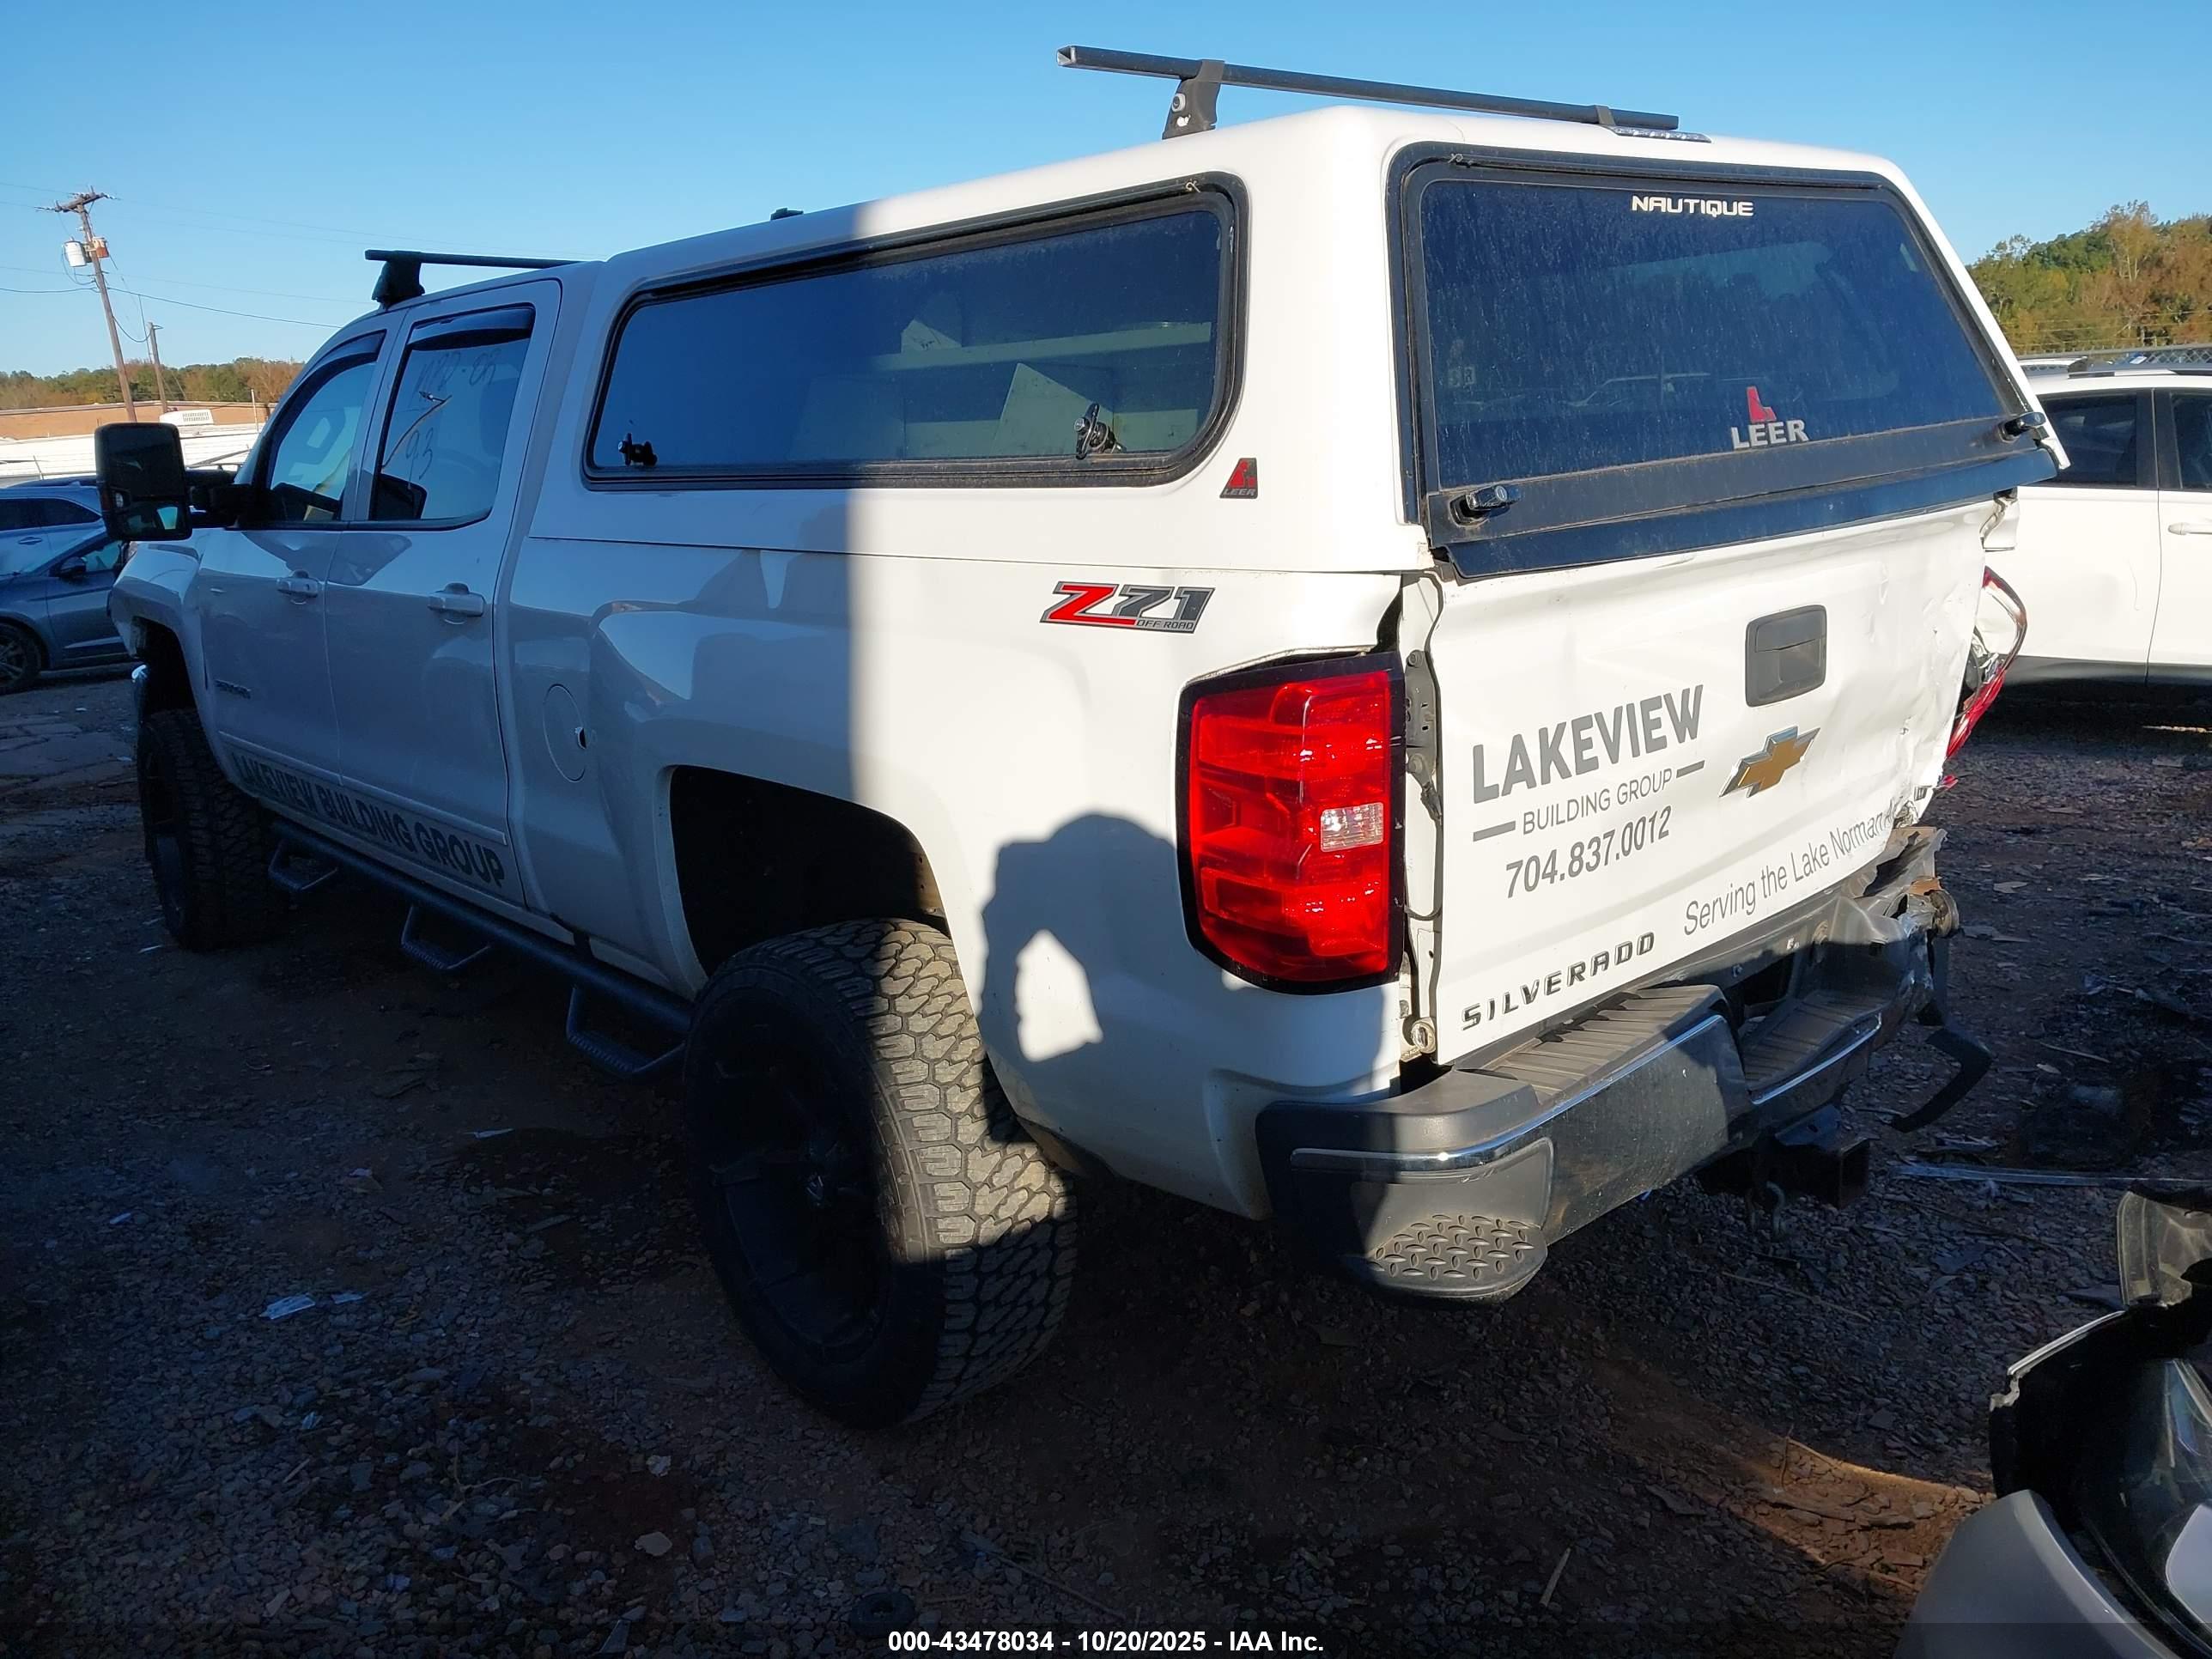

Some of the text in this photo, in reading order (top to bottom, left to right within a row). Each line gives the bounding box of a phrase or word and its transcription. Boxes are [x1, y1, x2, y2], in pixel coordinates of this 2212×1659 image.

[1632, 196, 1753, 217] NAUTIQUE
[1731, 419, 1810, 449] LEER
[1223, 488, 1256, 496] LEER
[1040, 581, 1215, 627] Z71
[1137, 619, 1194, 630] OFF ROAD
[1474, 684, 1704, 804] LAKEVIEW
[234, 753, 505, 886] LAKEVIEW BUILDING GROUP
[1522, 769, 1674, 835] BUILDING GROUP
[1505, 805, 1672, 898] 704.837.0012
[1684, 880, 1755, 936] Serving
[1760, 866, 1789, 899] the
[1790, 843, 1830, 882] Lake
[1462, 932, 1656, 1030] SILVERADO
